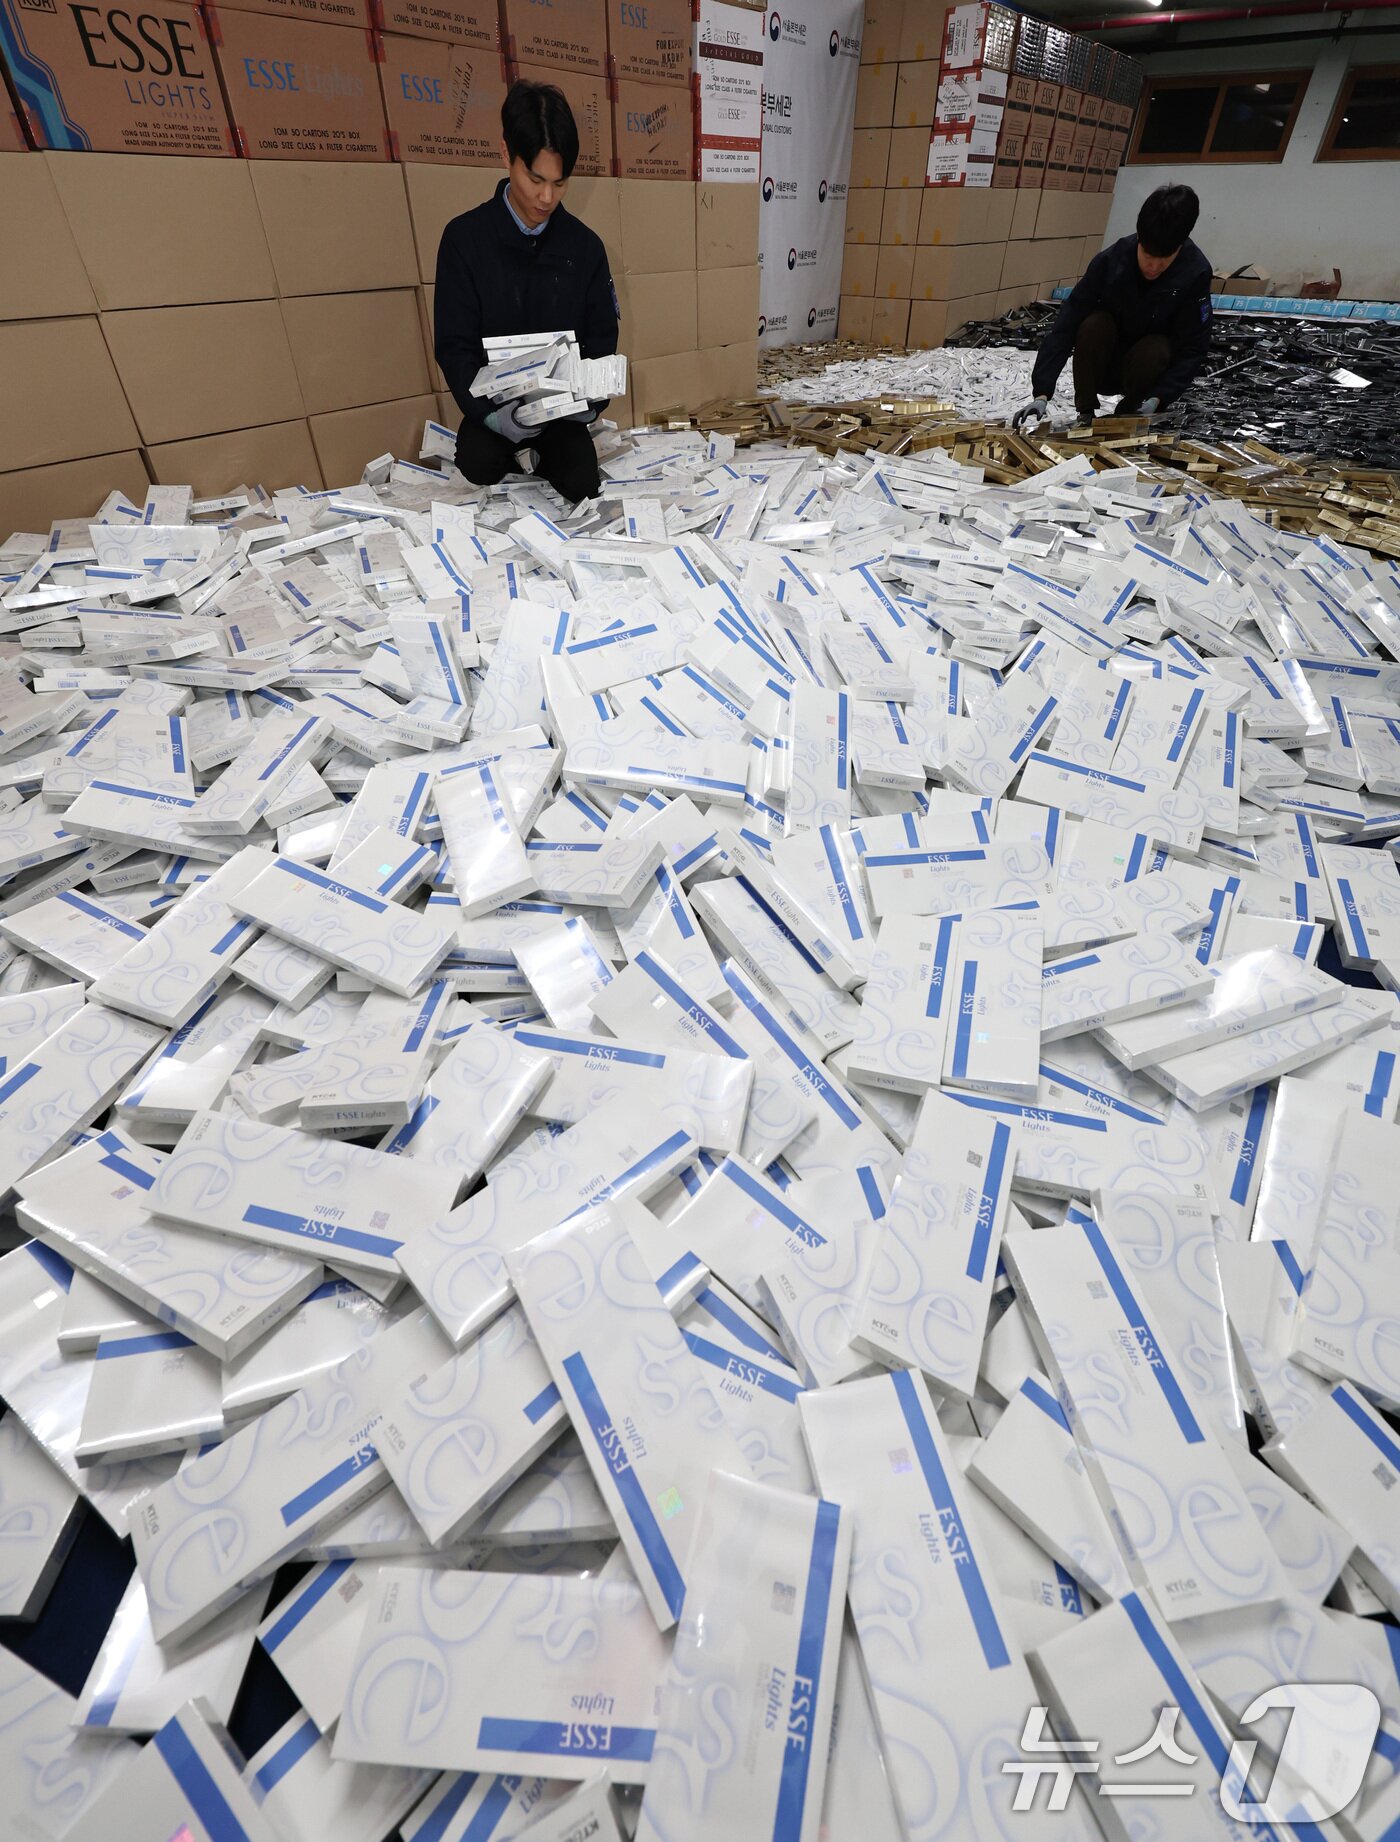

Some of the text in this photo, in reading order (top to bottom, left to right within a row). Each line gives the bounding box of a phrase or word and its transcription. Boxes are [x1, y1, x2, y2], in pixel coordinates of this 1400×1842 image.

[320, 3, 356, 16] CIGARETTES
[621, 2, 648, 29] ESSE
[67, 3, 205, 79] ESSE
[726, 31, 741, 46] ESSE
[243, 57, 299, 91] ESSE
[124, 79, 212, 110] LIGHTS
[400, 73, 444, 104] ESSE
[1016, 81, 1030, 101] ESSE
[1041, 87, 1055, 106] ESSE
[728, 108, 740, 120] ESSE
[291, 128, 300, 137] 50
[302, 128, 329, 138] CARTONS
[349, 131, 360, 140] BOX
[259, 140, 378, 153] LONG SIZE CLASS A FILTER CIGARETTES
[1005, 140, 1018, 157] ESSE
[1031, 141, 1043, 158] ESSE
[614, 631, 632, 643] ESSE
[723, 702, 744, 719] ESSE
[85, 726, 101, 742] ESSE
[1024, 726, 1036, 743] ESSE
[1177, 723, 1189, 740] ESSE
[172, 743, 181, 756] ESSE
[837, 740, 846, 760] ESSE
[1225, 749, 1233, 765] ESSE
[1085, 778, 1105, 790] Lights
[1088, 770, 1112, 783] ESSE
[151, 802, 174, 812] Lights
[156, 795, 183, 806] ESSE
[396, 816, 409, 838] ESSE
[928, 854, 950, 864] ESSE
[930, 864, 950, 874] Lights
[54, 878, 72, 892] ESSE
[326, 882, 353, 899] ESSE
[836, 881, 850, 905] ESSE
[319, 891, 341, 906] Lights
[771, 890, 787, 911] ESSE
[101, 915, 124, 930] ESSE
[494, 910, 518, 920] Lights
[1199, 932, 1212, 952] ESSE
[744, 956, 759, 977] ESSE
[932, 965, 944, 987] ESSE
[963, 991, 975, 1015] ESSE
[977, 995, 988, 1016] Lights
[415, 1014, 430, 1029] ESSE
[677, 1015, 699, 1039] Lights
[687, 1005, 714, 1032] ESSE
[173, 1023, 196, 1048] ESSE
[188, 1026, 208, 1047] Lights
[588, 1046, 620, 1062] ESSE
[583, 1059, 611, 1073] Lights
[791, 1074, 813, 1098] Lights
[800, 1064, 828, 1094] ESSE
[1084, 1099, 1111, 1118] Lights
[1087, 1088, 1118, 1109] ESSE
[336, 1109, 387, 1121] ESSE Lights
[1021, 1107, 1055, 1123] ESSE
[1022, 1119, 1051, 1133] Lights
[1226, 1130, 1240, 1154] Lights
[1239, 1138, 1255, 1167] ESSE
[578, 1174, 606, 1198] Lights
[964, 1186, 977, 1216] Lights
[313, 1204, 345, 1221] Lights
[976, 1194, 993, 1230] ESSE
[299, 1217, 340, 1239] ESSE
[871, 1318, 899, 1339] KT&G
[1117, 1327, 1141, 1367] Lights
[1133, 1325, 1165, 1370] ESSE
[725, 1357, 767, 1388] ESSE
[718, 1377, 755, 1404] Lights
[348, 1414, 384, 1447] Lights
[622, 1416, 648, 1460] Lights
[597, 1424, 633, 1475] ESSE
[918, 1511, 943, 1564] Lights
[938, 1506, 971, 1568] ESSE
[1164, 1578, 1198, 1595] KT&G
[571, 1692, 616, 1716] Lights
[765, 1666, 787, 1732] Lights
[787, 1674, 814, 1753] ESSE
[559, 1721, 612, 1751] ESSE
